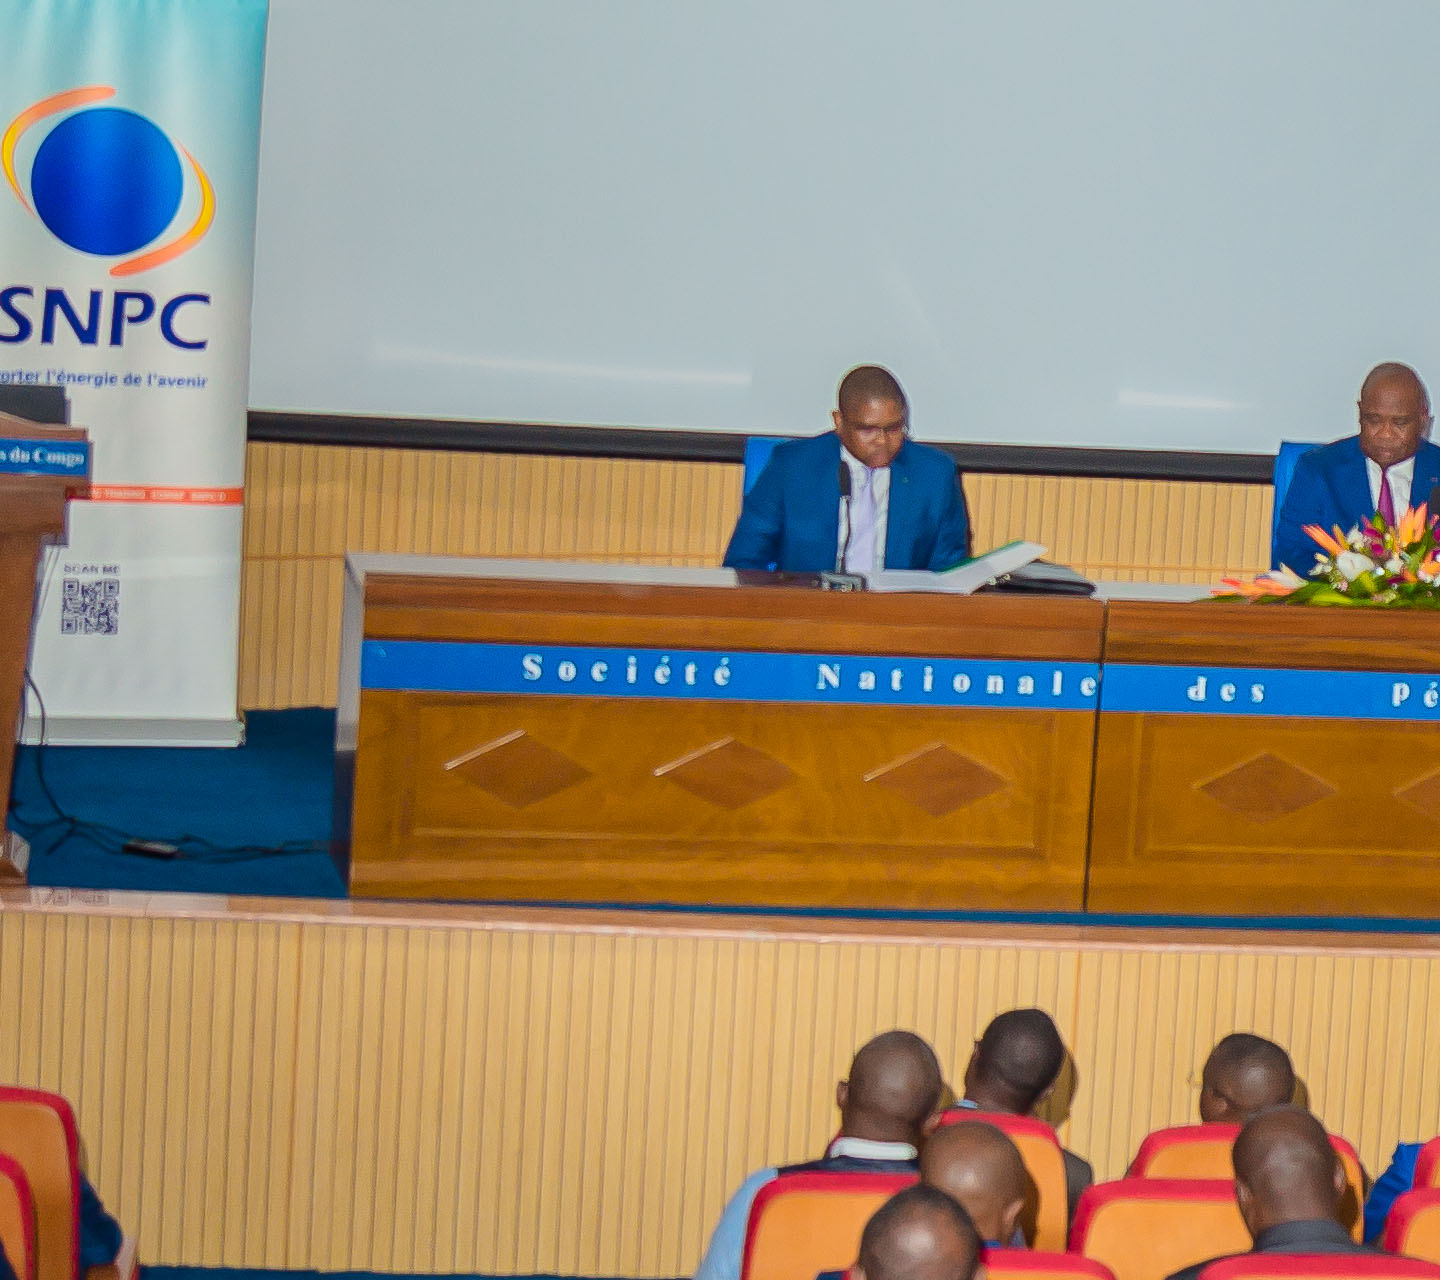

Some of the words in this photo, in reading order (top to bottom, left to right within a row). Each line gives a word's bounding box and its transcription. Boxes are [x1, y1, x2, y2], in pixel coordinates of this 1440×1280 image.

[46, 368, 117, 389] l'énergie
[122, 373, 142, 387] de
[147, 373, 209, 389] l'avenir
[10, 445, 31, 464] du
[34, 446, 85, 470] Congo
[63, 564, 100, 575] SCAN
[102, 564, 121, 575] ME
[522, 653, 732, 687] Société
[817, 662, 1098, 697] Nationale
[1187, 676, 1267, 705] des
